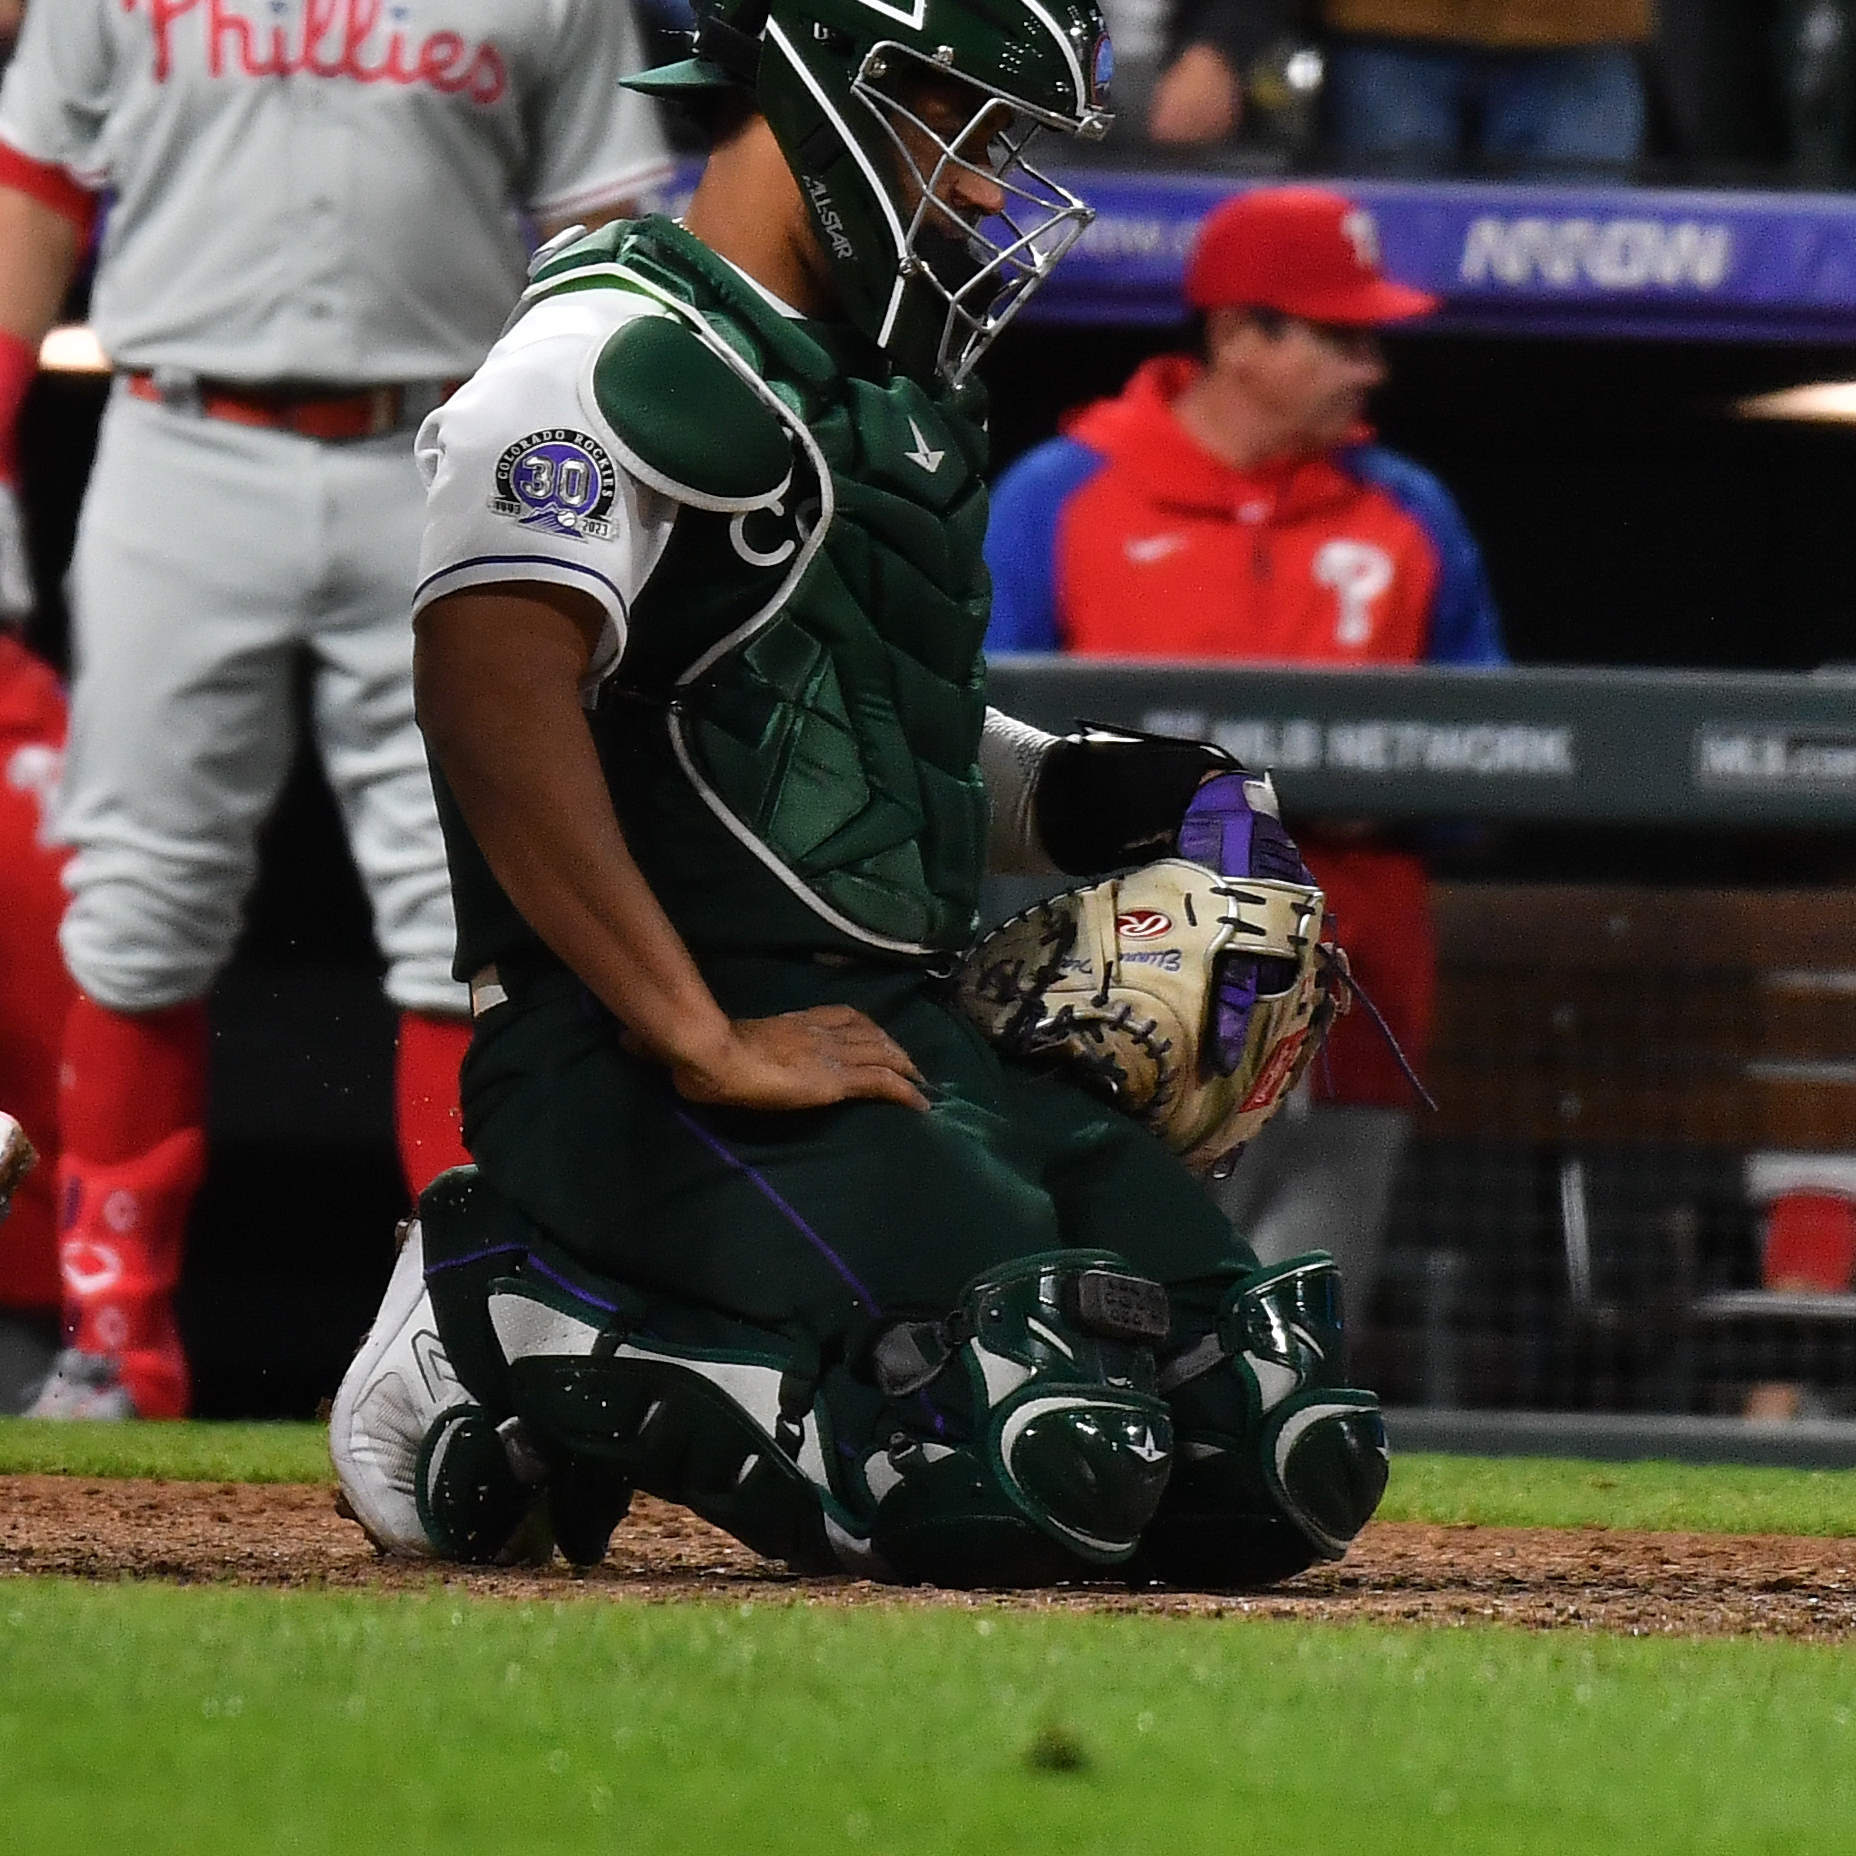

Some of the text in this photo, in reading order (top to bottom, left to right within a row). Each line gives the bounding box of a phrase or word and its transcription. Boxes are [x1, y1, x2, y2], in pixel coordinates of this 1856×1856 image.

[496, 429, 616, 499] COLORADO ROCKIES
[519, 454, 591, 508] 30
[1326, 722, 1574, 776] NETWORK
